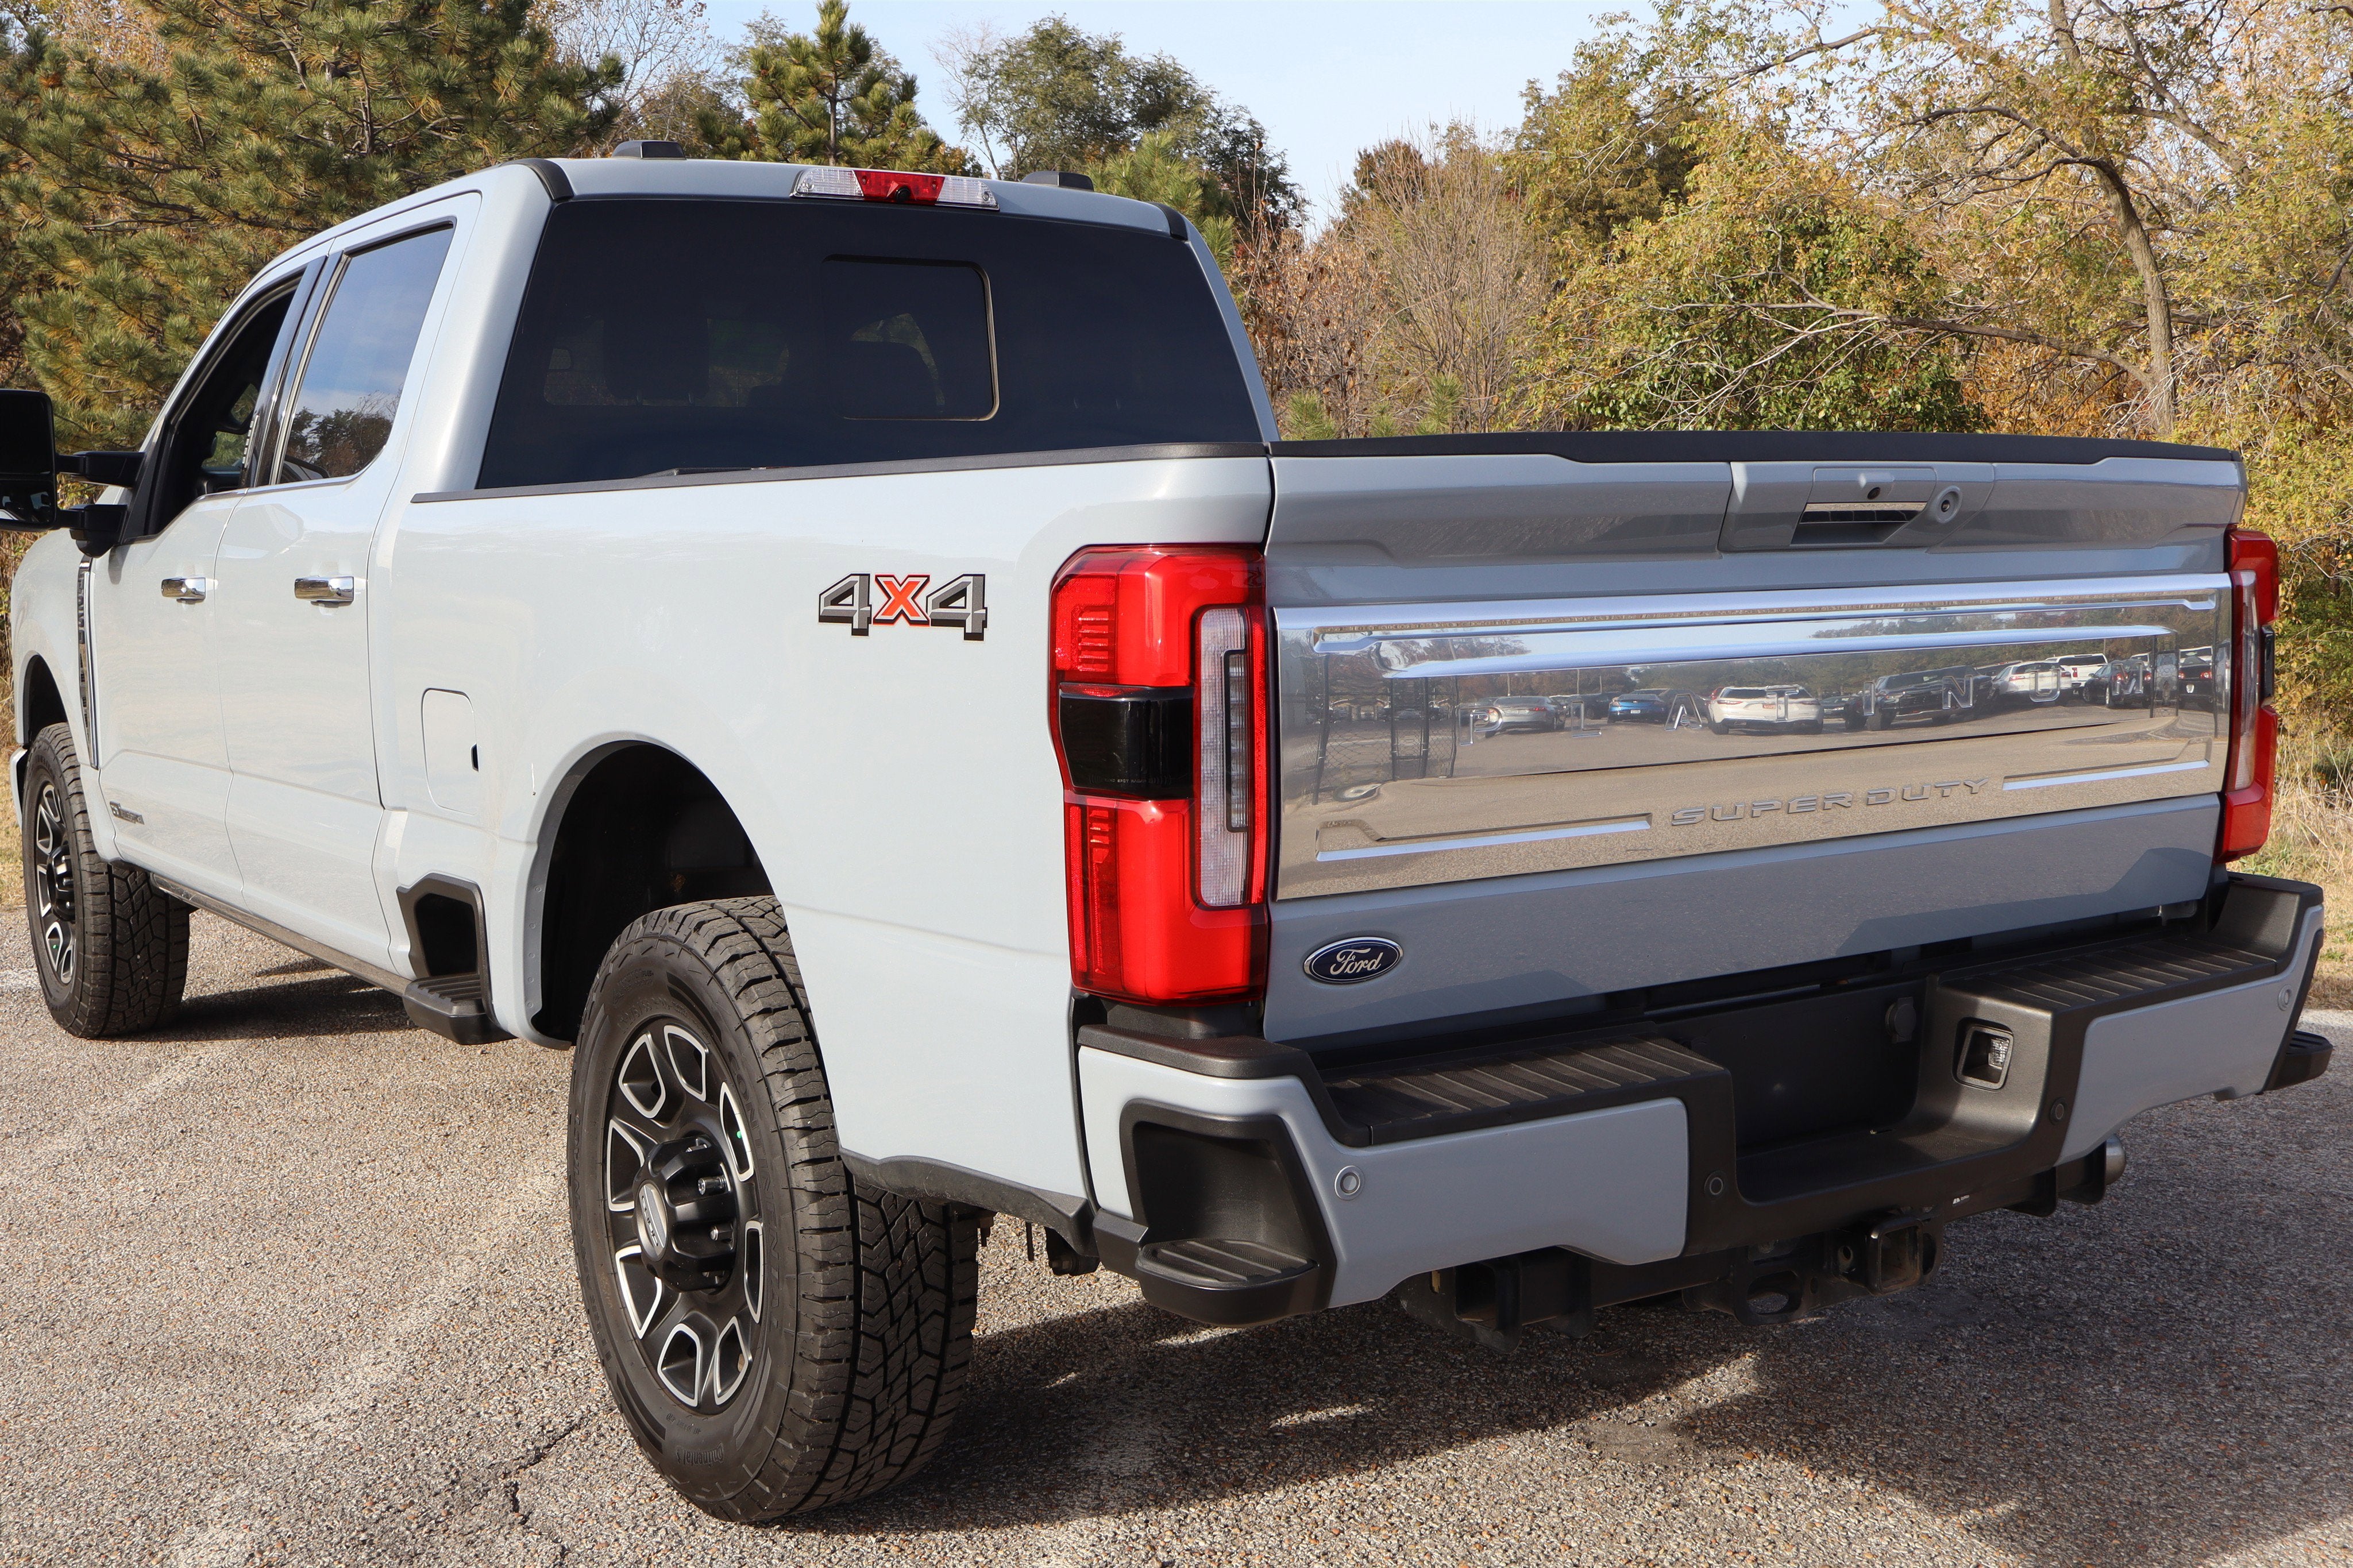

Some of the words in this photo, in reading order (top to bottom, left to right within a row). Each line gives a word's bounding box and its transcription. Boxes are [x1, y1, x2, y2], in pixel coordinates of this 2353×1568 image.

[1459, 662, 2144, 746] PLATINUM
[1672, 790, 1853, 827] SUPER
[1866, 778, 1989, 806] DUTY
[1330, 948, 1383, 975] Ford
[682, 1442, 724, 1467] Continental
